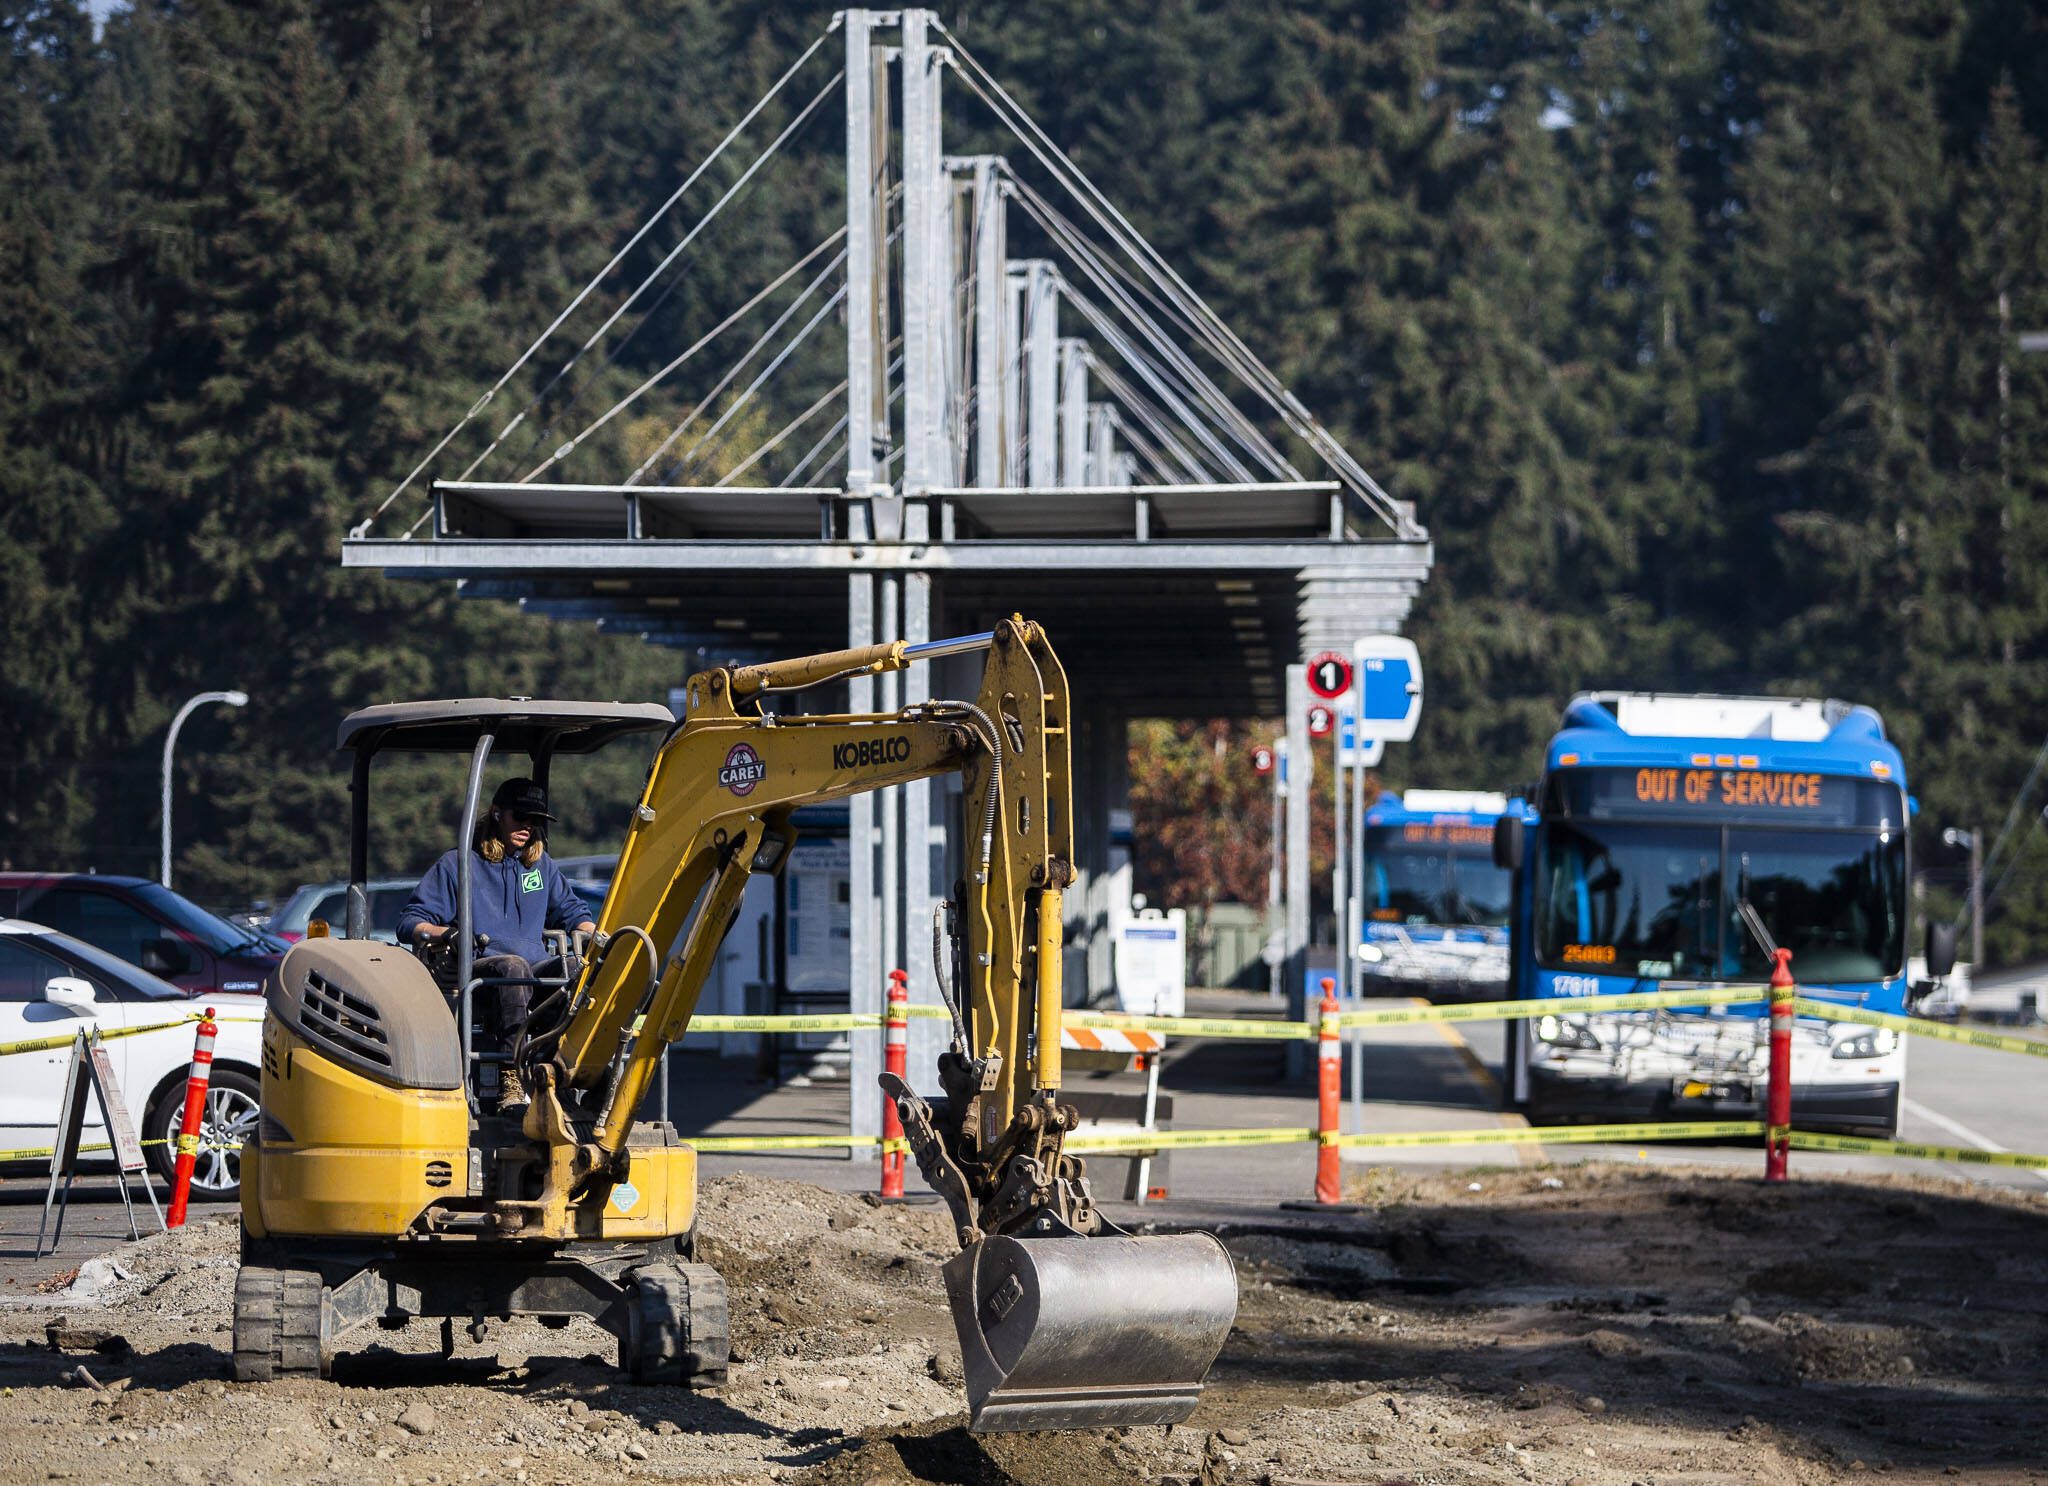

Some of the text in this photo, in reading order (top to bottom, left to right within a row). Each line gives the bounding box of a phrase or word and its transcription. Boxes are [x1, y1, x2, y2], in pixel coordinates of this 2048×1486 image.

[1320, 662, 1335, 690] 1
[1310, 708, 1328, 732] 2
[833, 736, 910, 770] KOBELCO
[720, 764, 764, 783] CAREY
[1636, 768, 1822, 807] OUT OF SERVICE
